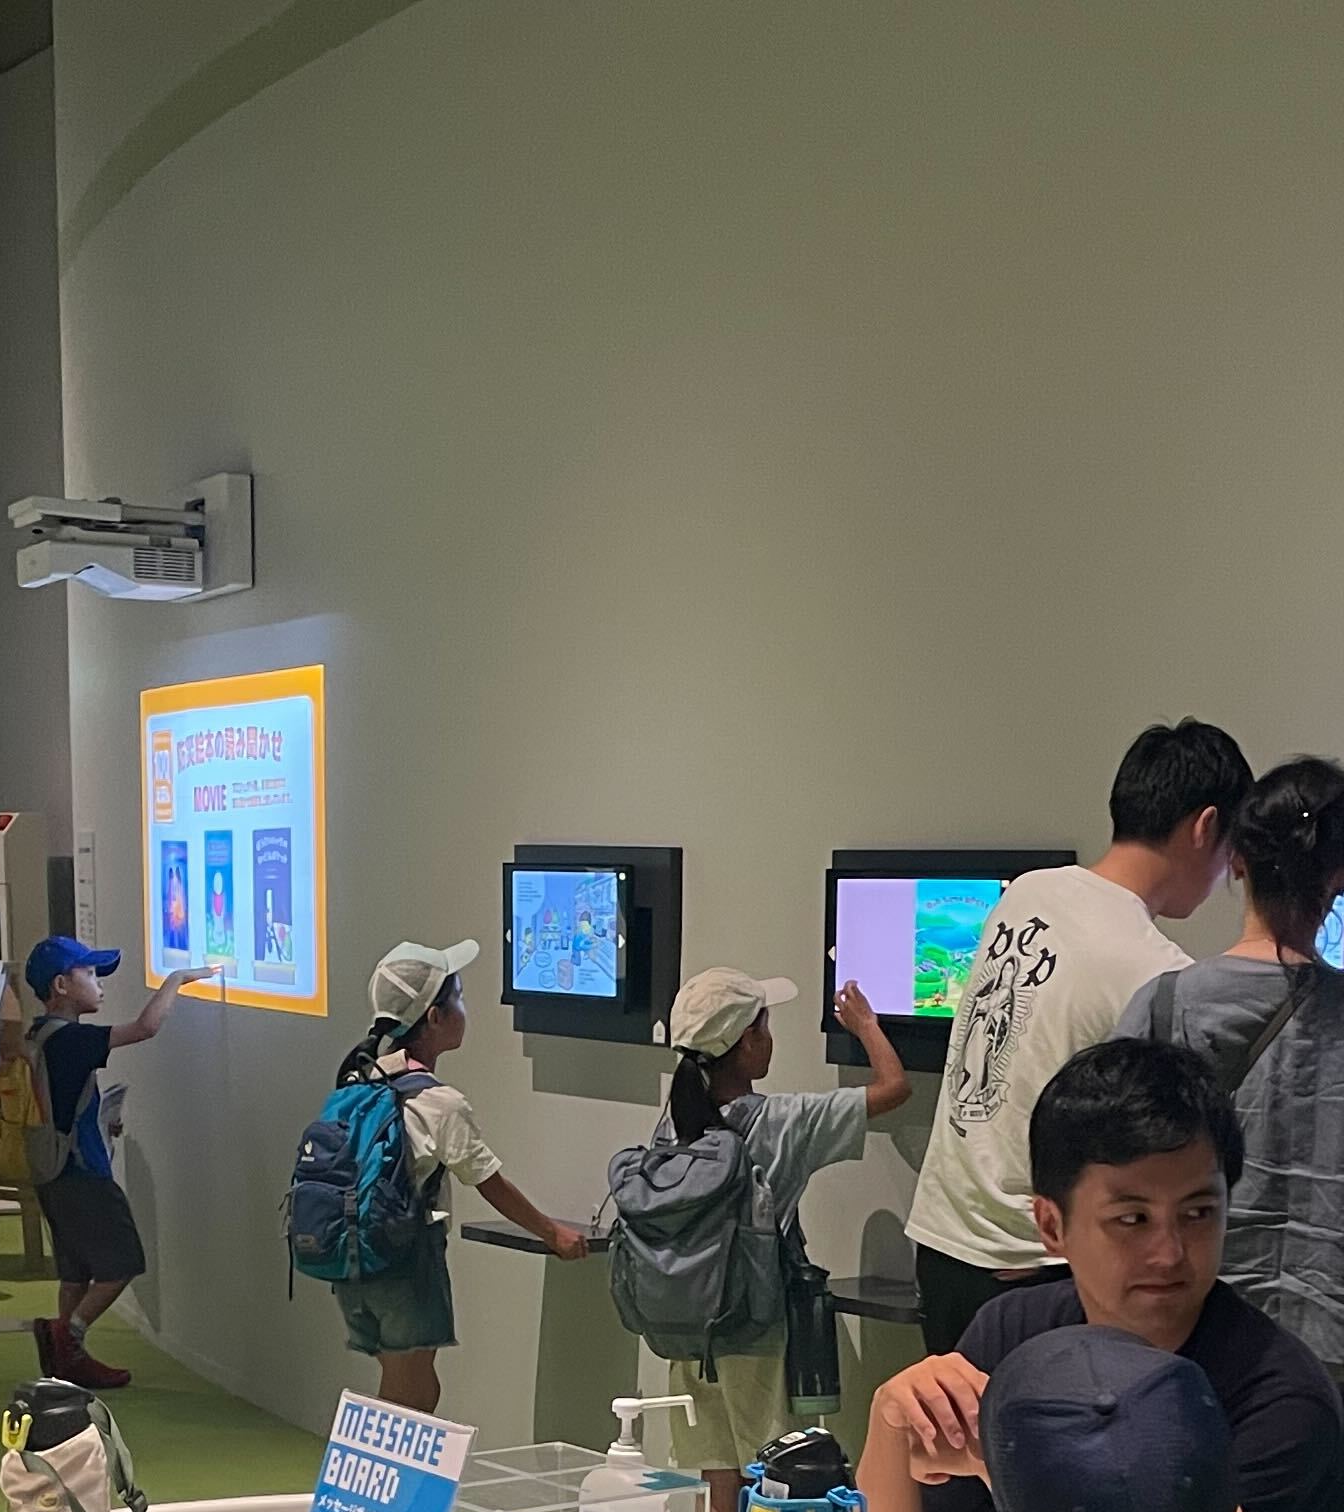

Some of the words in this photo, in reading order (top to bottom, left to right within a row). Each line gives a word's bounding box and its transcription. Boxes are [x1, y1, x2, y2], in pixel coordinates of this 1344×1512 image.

[193, 784, 227, 813] MOVIE
[338, 1402, 447, 1467] MESSAGE
[323, 1447, 400, 1505] BOARD
